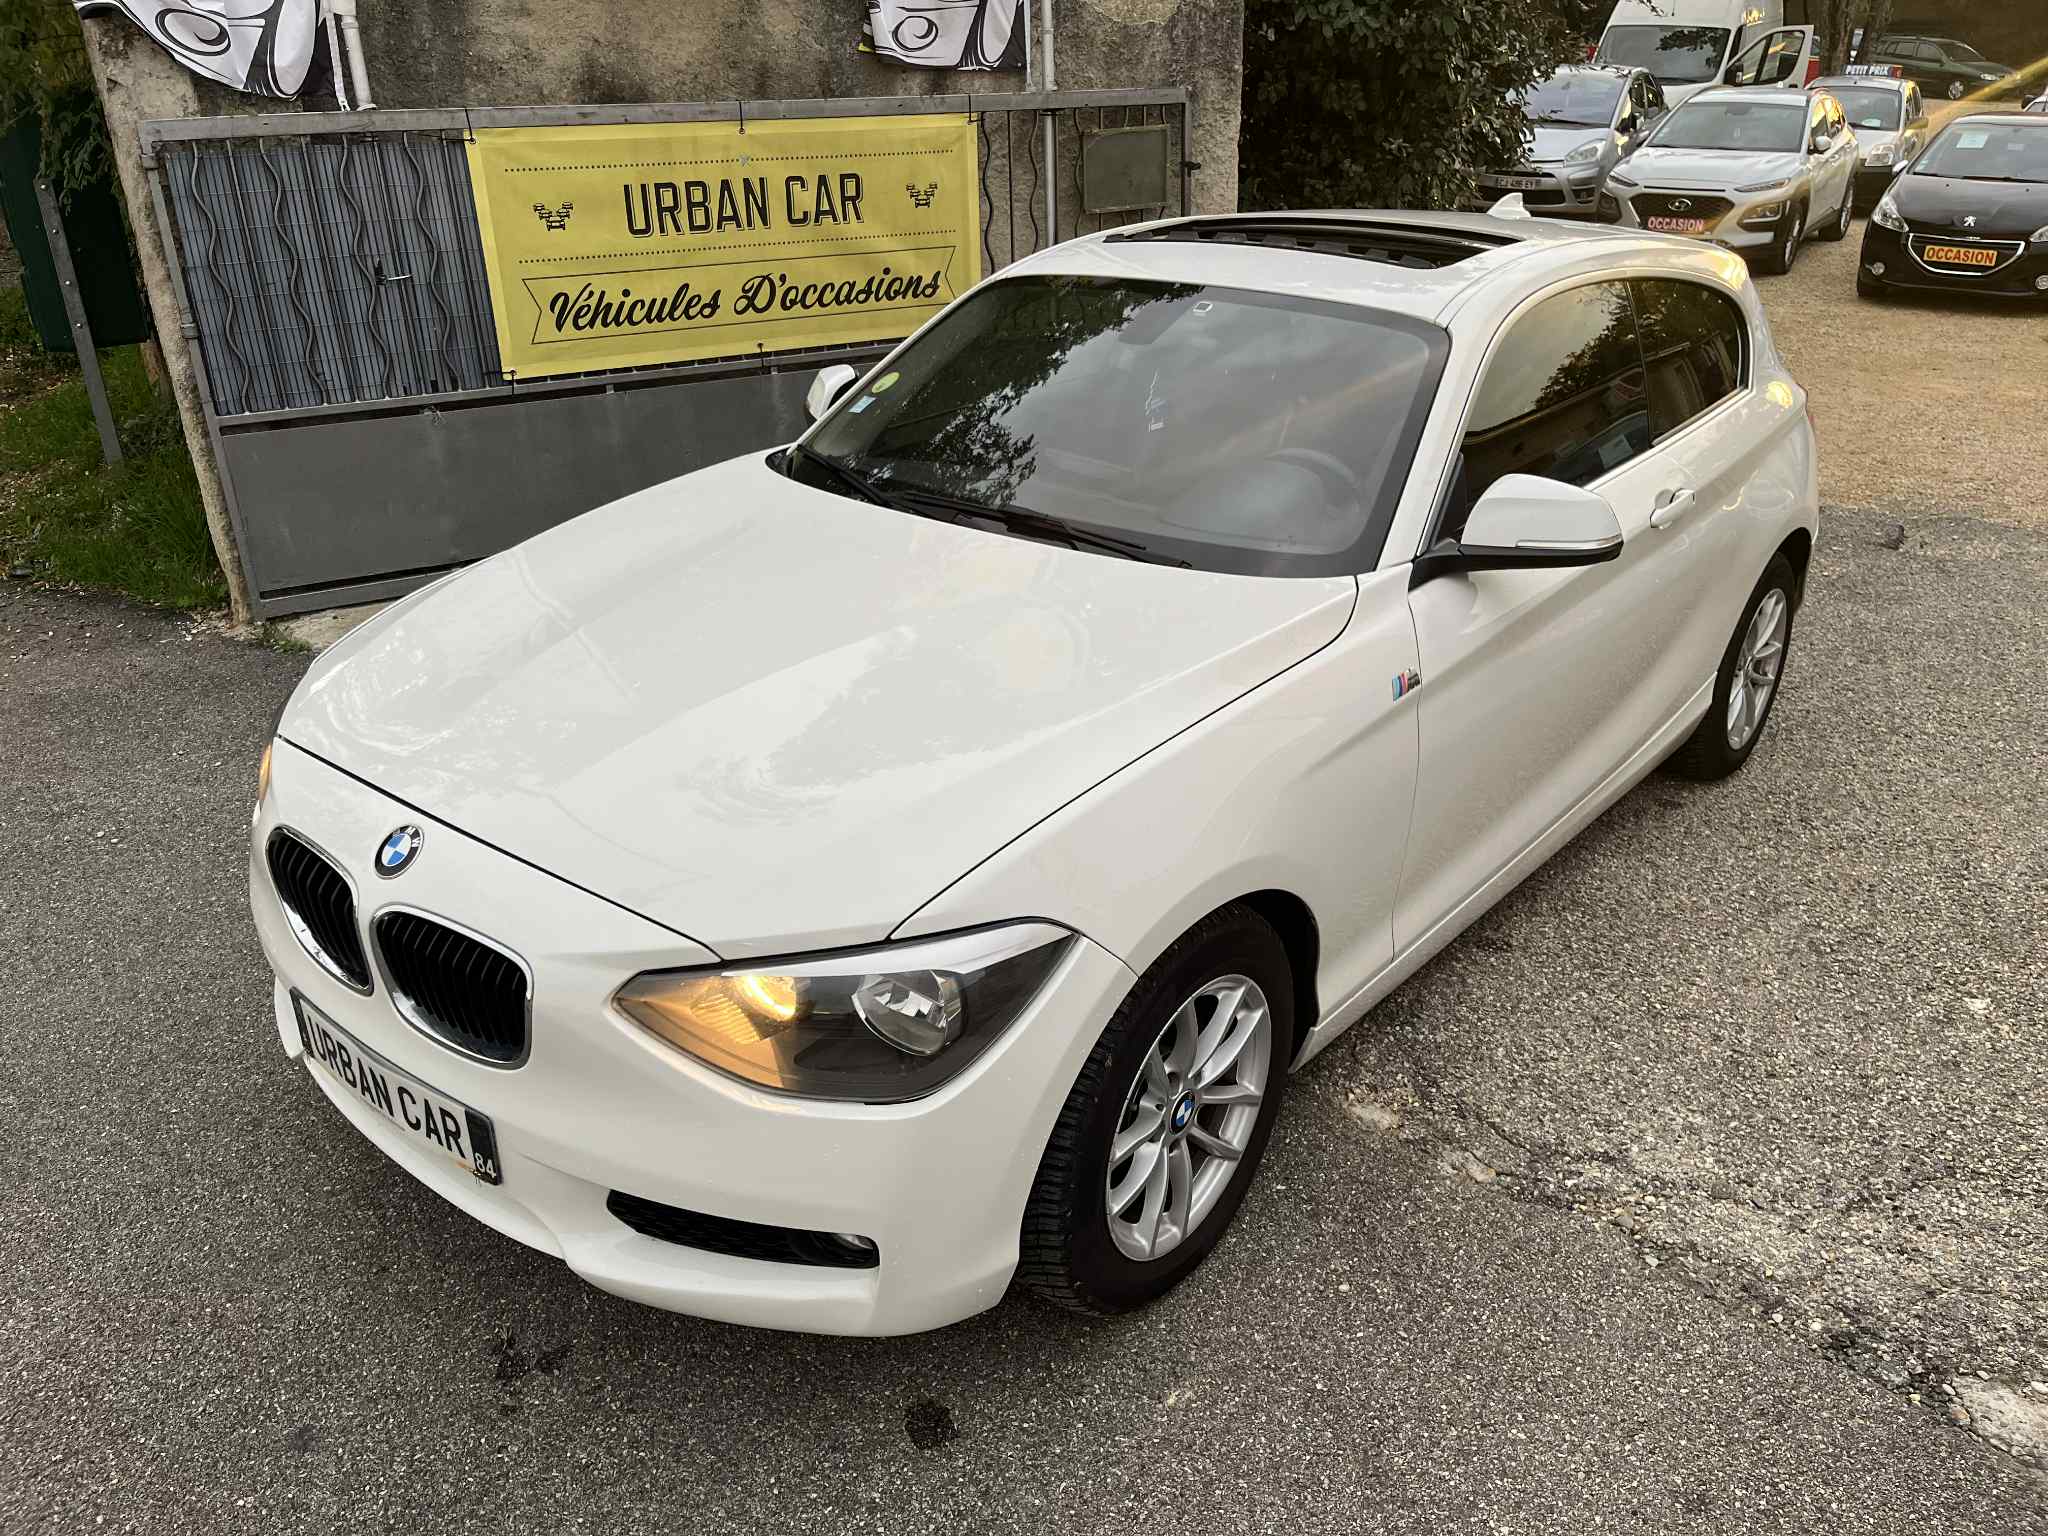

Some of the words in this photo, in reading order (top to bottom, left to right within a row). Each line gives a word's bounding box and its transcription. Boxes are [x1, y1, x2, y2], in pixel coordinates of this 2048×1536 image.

[1845, 64, 1869, 75] PETIT
[1869, 64, 1889, 76] PRIX
[623, 176, 771, 238] URBAN
[784, 172, 865, 227] CAR
[1648, 215, 1704, 232] OCCASION
[1926, 247, 1995, 265] OCCASION
[549, 282, 722, 333] Véhicules
[733, 266, 942, 316] D'occasions
[307, 1014, 395, 1118] URBAN
[397, 1085, 467, 1160] CAR
[474, 1152, 497, 1179] 84
